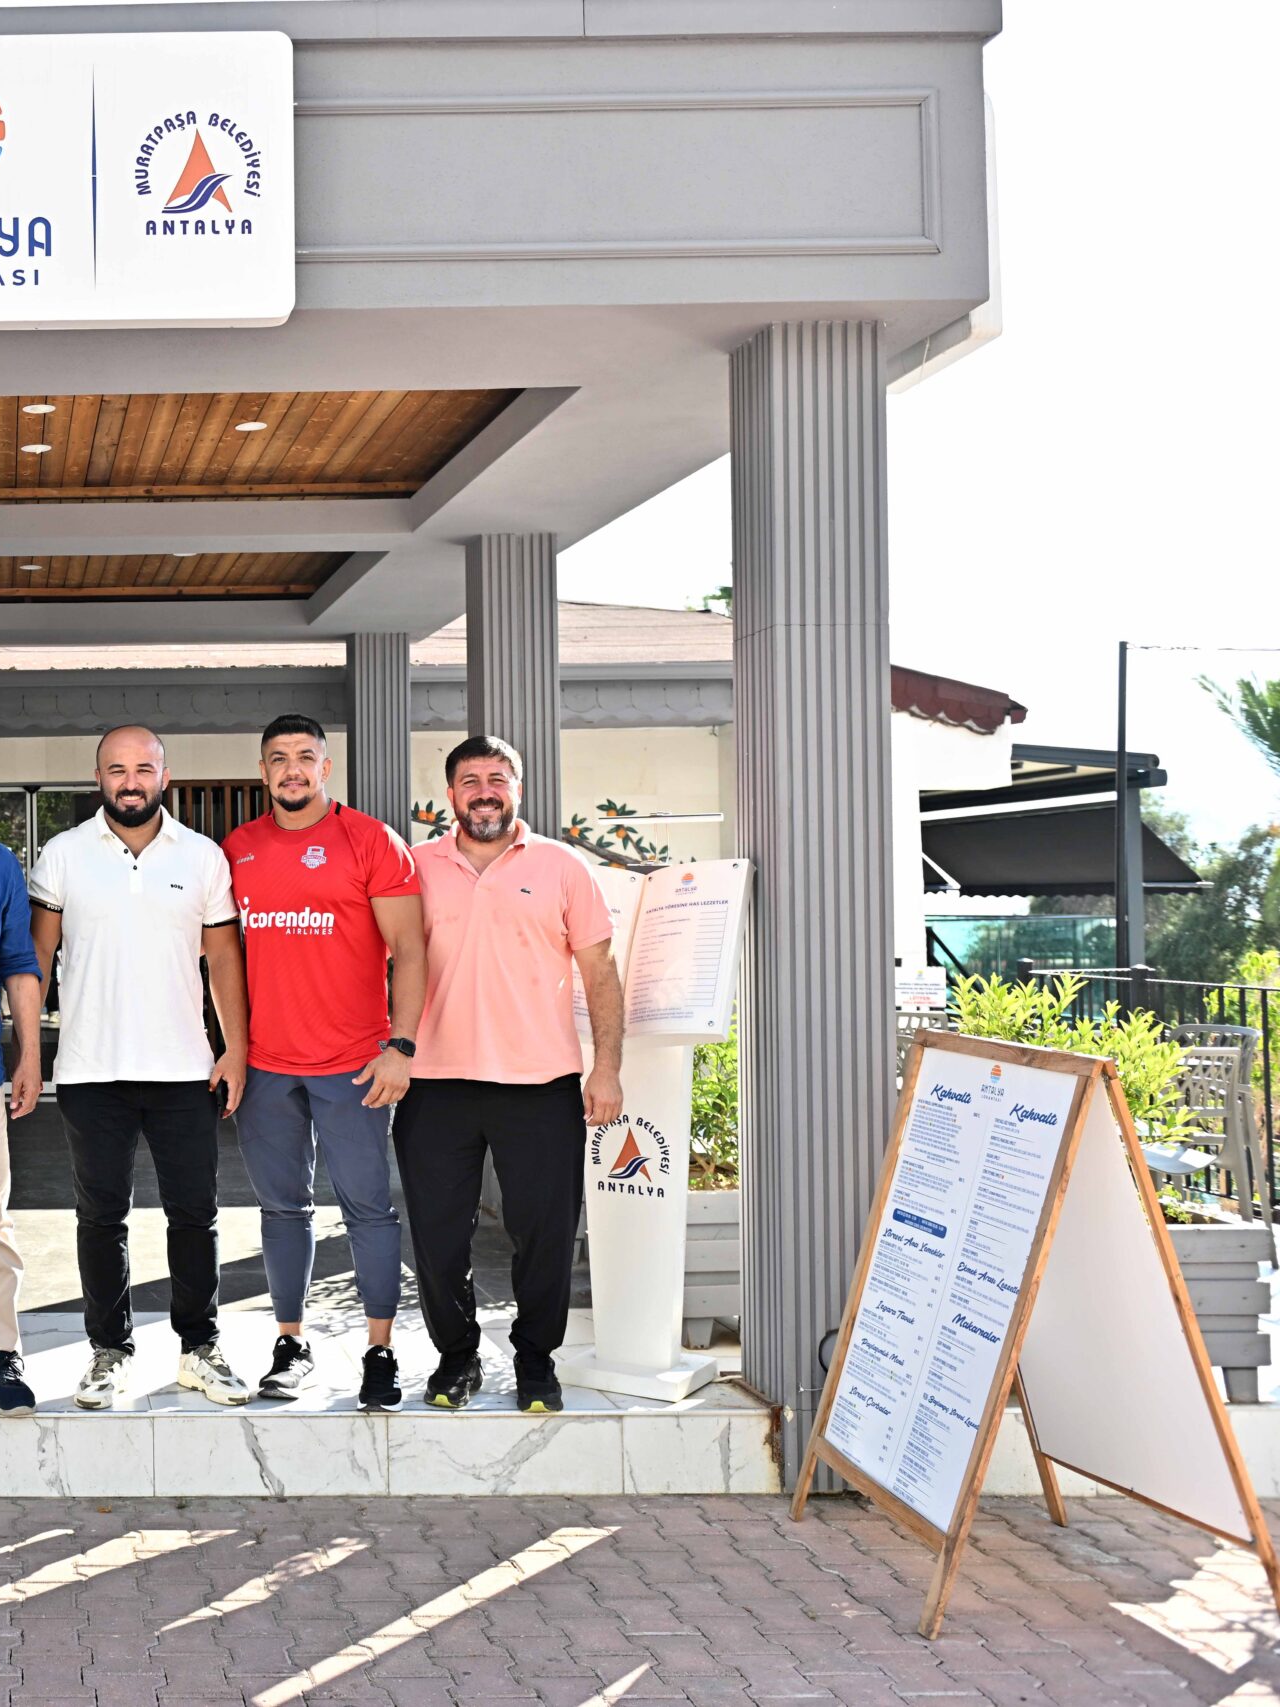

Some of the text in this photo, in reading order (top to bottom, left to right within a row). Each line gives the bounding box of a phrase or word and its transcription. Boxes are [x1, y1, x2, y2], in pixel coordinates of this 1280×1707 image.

[135, 111, 261, 197] MURATPAŞA BELEDİYESİ
[146, 219, 252, 235] ANTALYA
[249, 906, 334, 928] corendon
[636, 1117, 670, 1175] BELEDİYESİ
[598, 1181, 664, 1197] ANTALYA
[952, 1313, 1000, 1344] Makarnalar
